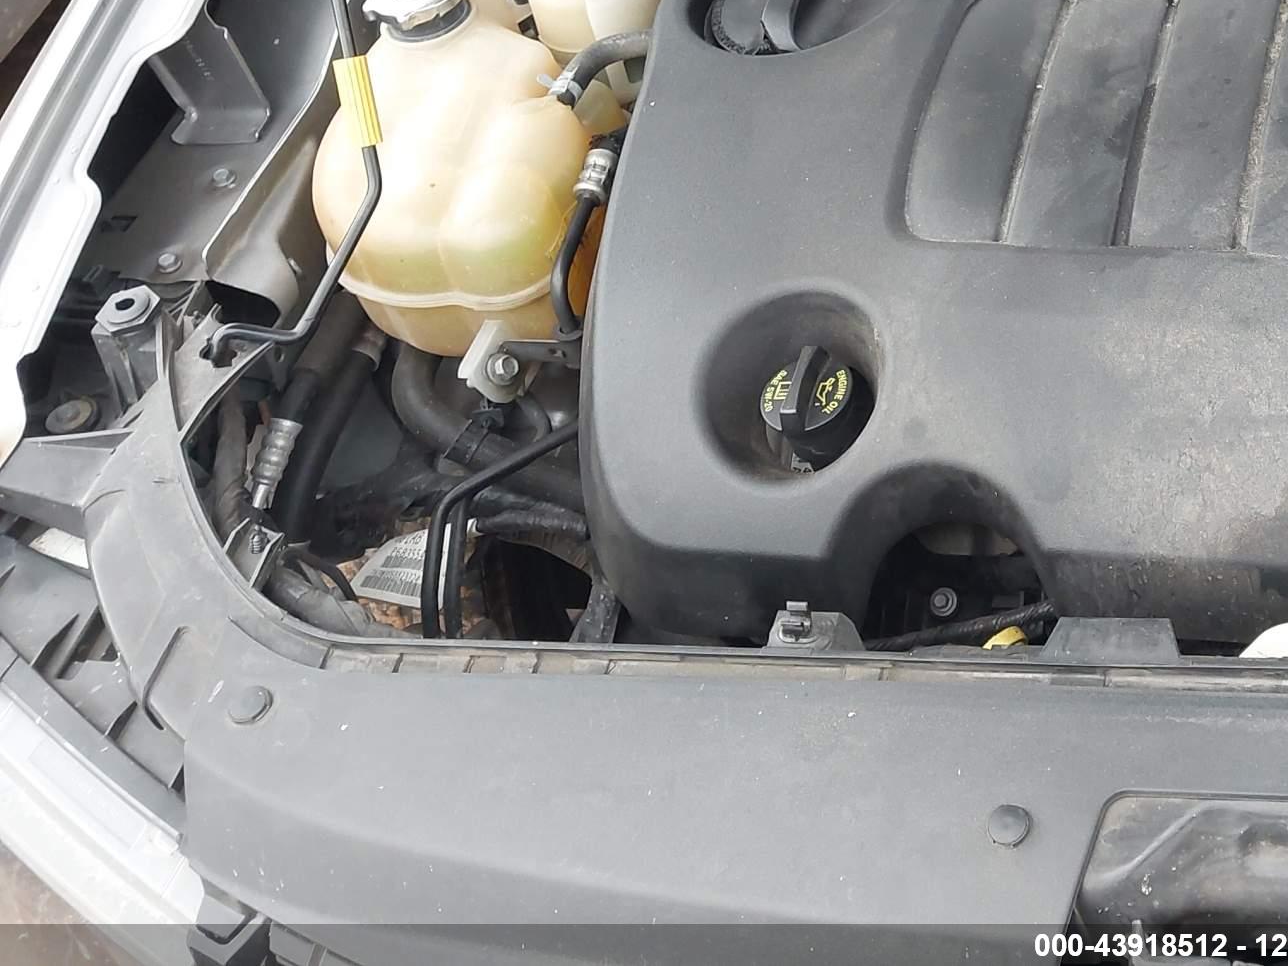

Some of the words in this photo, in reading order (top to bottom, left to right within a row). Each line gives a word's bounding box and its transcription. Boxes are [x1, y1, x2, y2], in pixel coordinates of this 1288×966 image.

[771, 369, 788, 389] SAE
[834, 369, 849, 401] ENGINE
[821, 401, 839, 415] OIL
